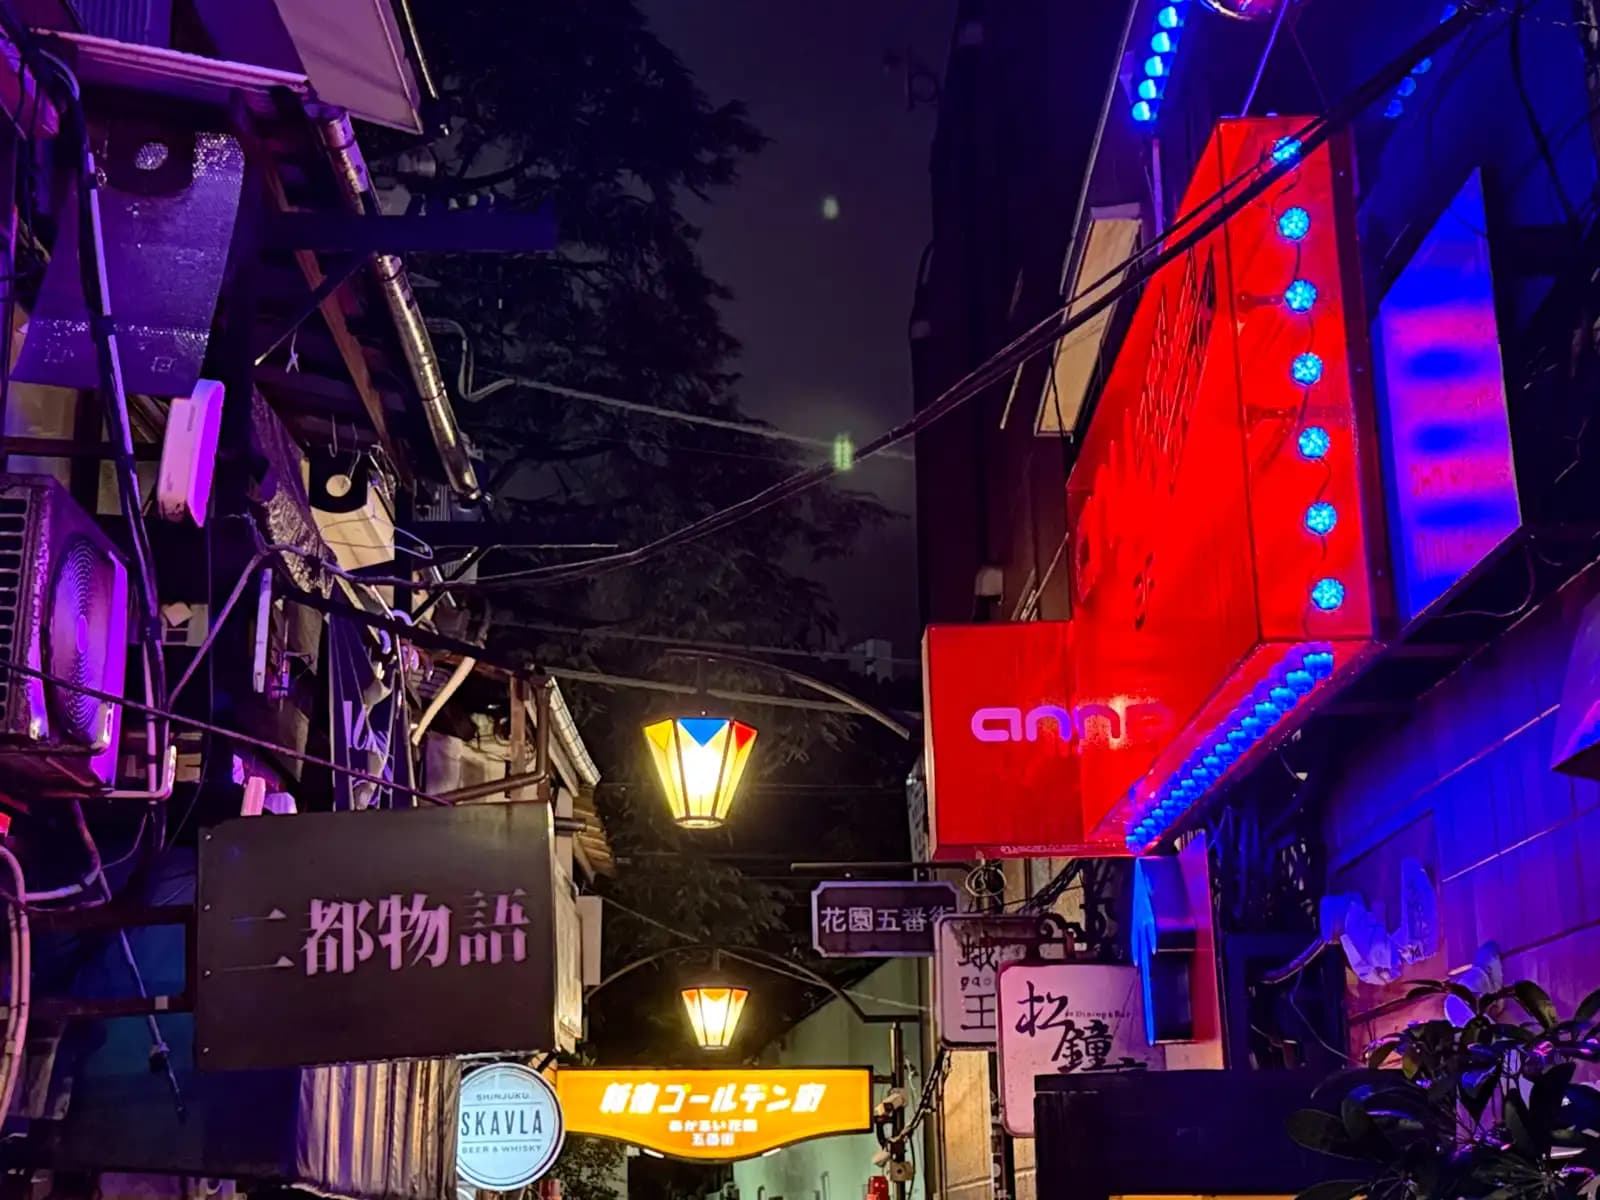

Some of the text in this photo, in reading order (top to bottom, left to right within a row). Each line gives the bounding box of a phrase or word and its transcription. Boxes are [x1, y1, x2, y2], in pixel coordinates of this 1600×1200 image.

[221, 888, 531, 976] 二都物語
[475, 1092, 530, 1102] SHINJUKU
[461, 1110, 543, 1137] SKAVLA
[462, 1144, 489, 1155] BEER
[502, 1143, 542, 1153] WHISKY
